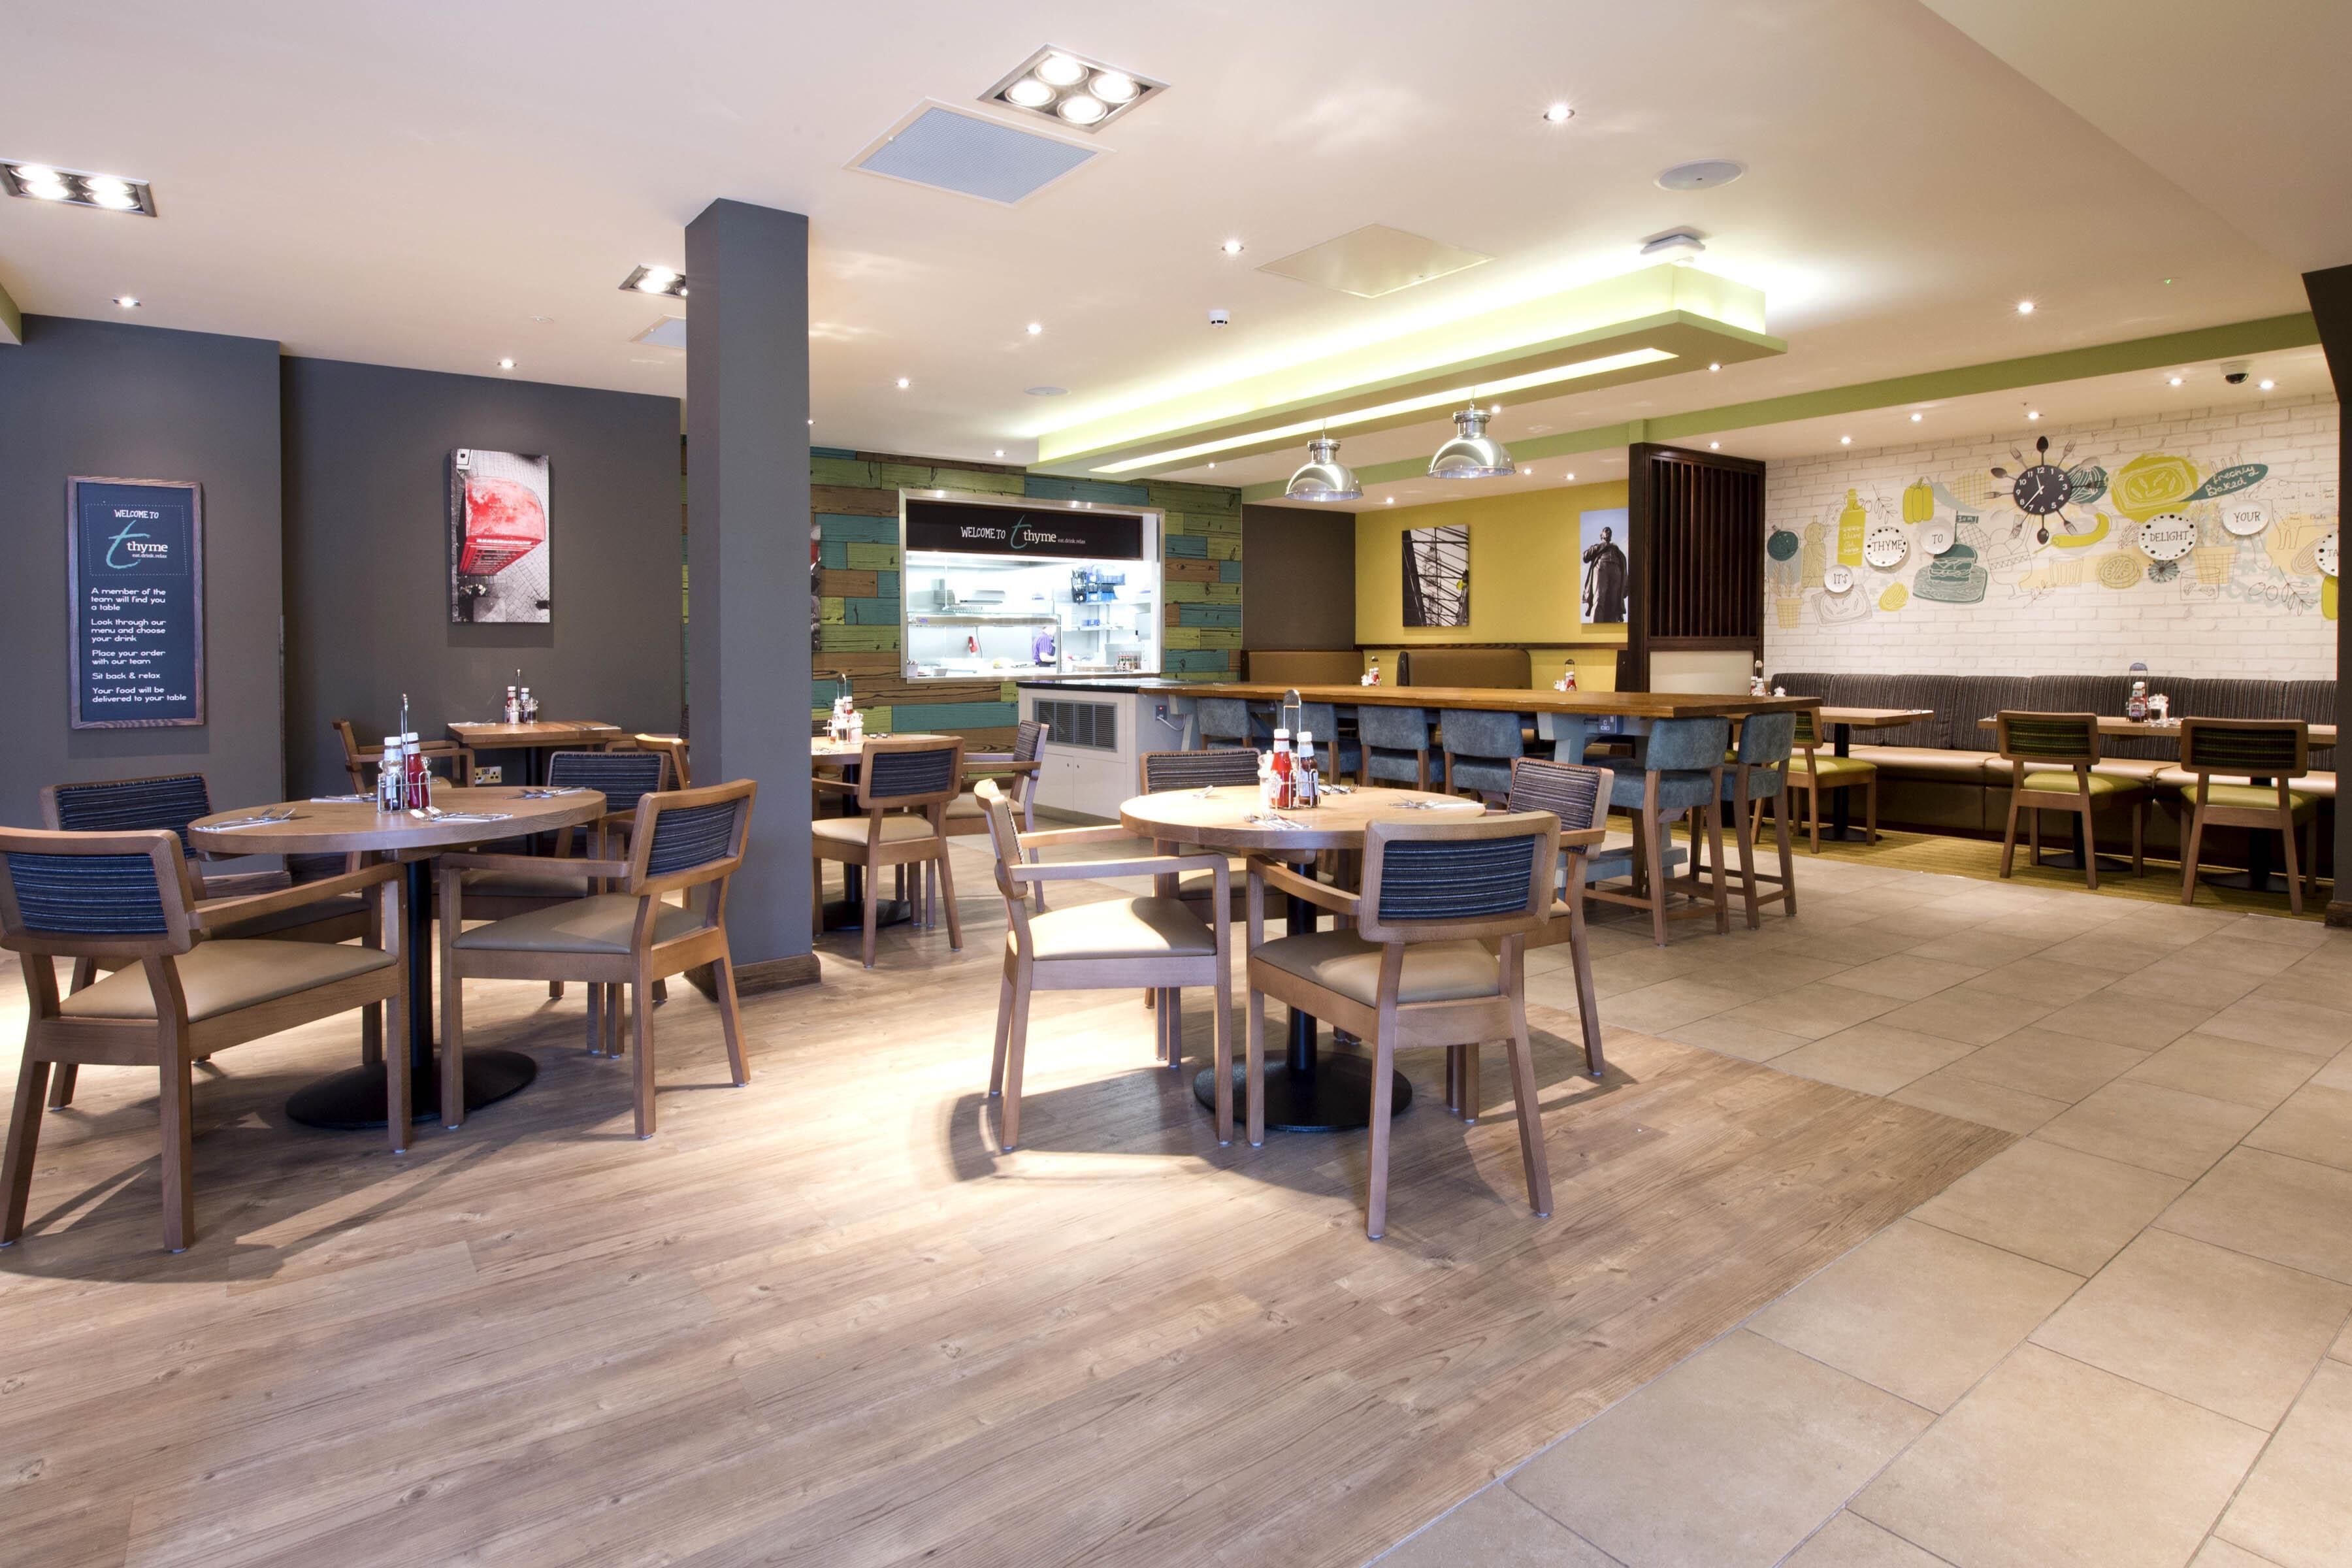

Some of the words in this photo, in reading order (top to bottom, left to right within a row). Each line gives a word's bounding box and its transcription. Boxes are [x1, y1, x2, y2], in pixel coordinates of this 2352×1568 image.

[2206, 477, 2247, 496] Baked
[114, 510, 148, 519] WELCOME
[2234, 512, 2261, 523] YOUR
[960, 527, 995, 539] WELCOME
[996, 530, 1006, 539] TO
[1011, 514, 1032, 549] t
[1023, 530, 1057, 544] thyme
[2150, 531, 2189, 542] DELIGHT
[1932, 534, 1943, 544] TO
[127, 541, 168, 553] thyme
[1872, 540, 1903, 551] THYME
[1833, 574, 1848, 584] IT'S
